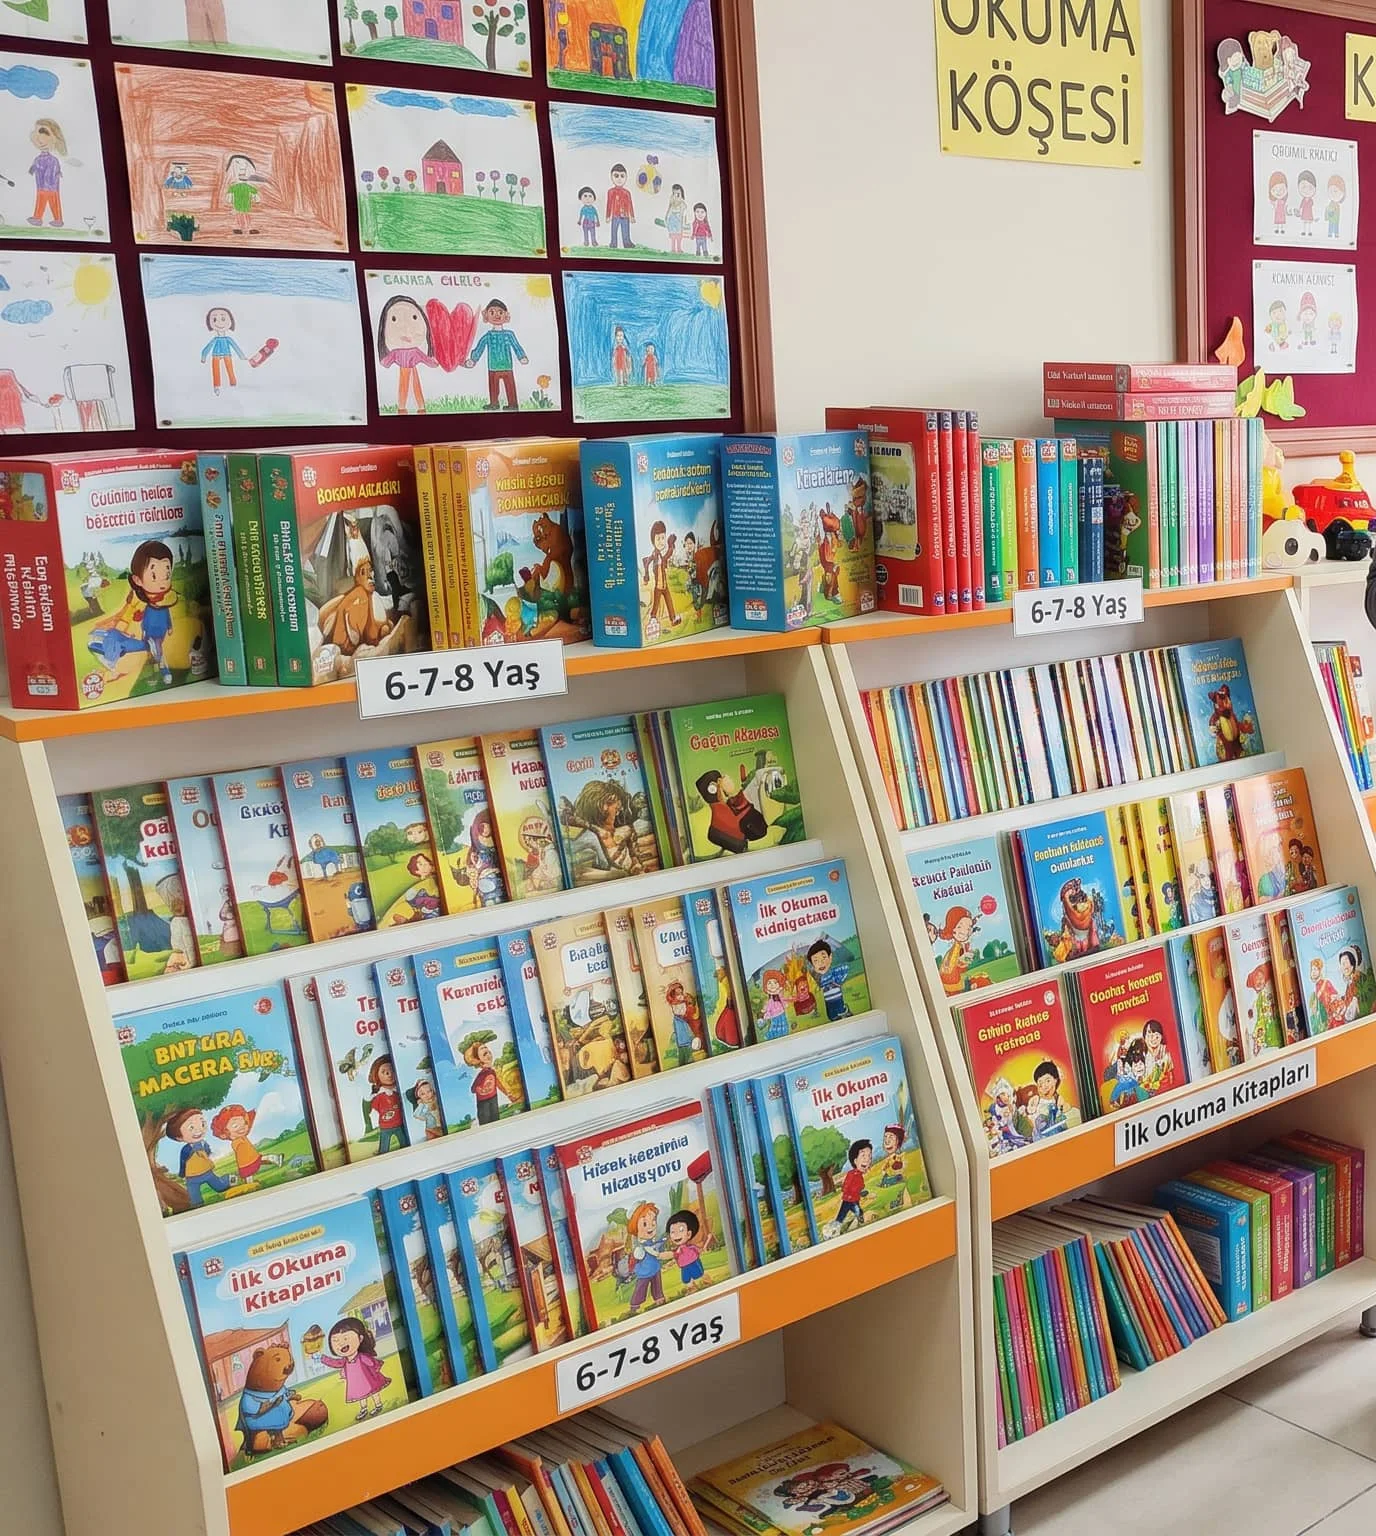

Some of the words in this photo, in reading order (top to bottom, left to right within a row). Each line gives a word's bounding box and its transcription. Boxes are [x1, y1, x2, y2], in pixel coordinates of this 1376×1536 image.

[941, 0, 1135, 56] OKUMA
[949, 59, 1129, 155] KÖŞESİ
[1031, 596, 1085, 624] 6-7-8
[1092, 594, 1127, 619] Yaş
[385, 664, 474, 700] 6-7-8
[483, 660, 540, 690] Yaş
[138, 1055, 234, 1098] MACERA
[836, 1072, 888, 1097] Okuma
[1124, 1122, 1149, 1150] İlk
[1156, 1097, 1226, 1137] Okuma
[1232, 1063, 1309, 1107] Kitapları
[267, 1245, 347, 1281] Okuma
[245, 1270, 342, 1313] Kitapları
[576, 1334, 660, 1392] 6-7-8
[670, 1314, 724, 1352] Yaş
